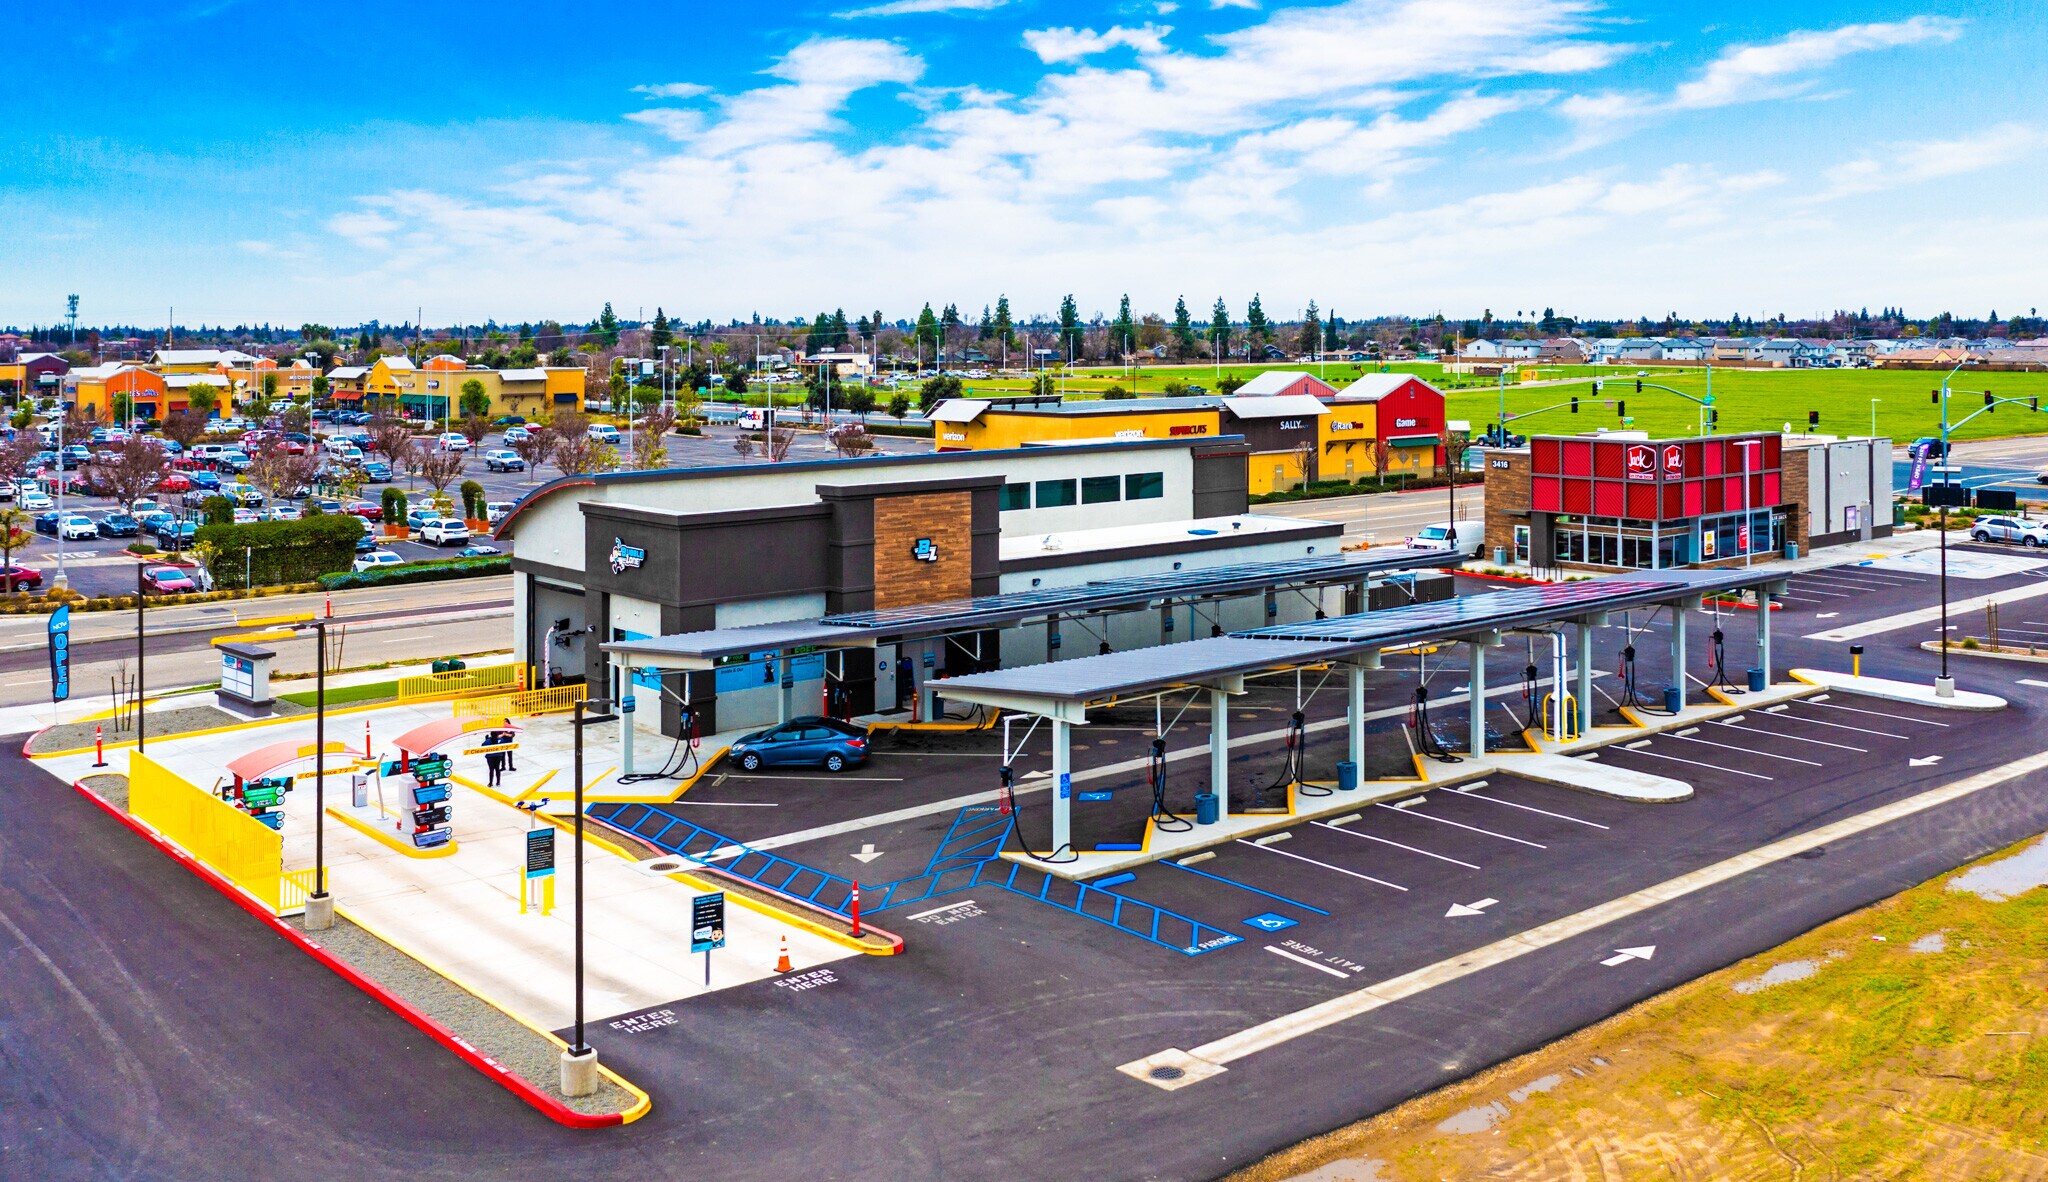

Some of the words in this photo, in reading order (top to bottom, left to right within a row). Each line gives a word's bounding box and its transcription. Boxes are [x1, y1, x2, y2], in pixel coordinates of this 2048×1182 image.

[744, 410, 761, 421] FedEx
[1169, 425, 1207, 436] SUPERCUTS
[1280, 420, 1301, 430] SALLY
[943, 432, 965, 441] verizon
[1115, 429, 1143, 438] verizon
[1492, 460, 1509, 468] 3416
[1628, 450, 1653, 468] Jack
[54, 633, 68, 698] OPEN
[470, 747, 499, 755] Clearance
[917, 914, 941, 924] DO
[947, 904, 979, 915] NOT
[935, 908, 988, 926] ENTER
[1198, 936, 1238, 950] PARKING
[1281, 939, 1324, 957] HERE
[1325, 956, 1366, 973] WAIT
[774, 968, 835, 988] ENTER
[789, 976, 839, 992] HERE
[609, 1008, 676, 1031] ENTER
[624, 1016, 679, 1035] HERE
